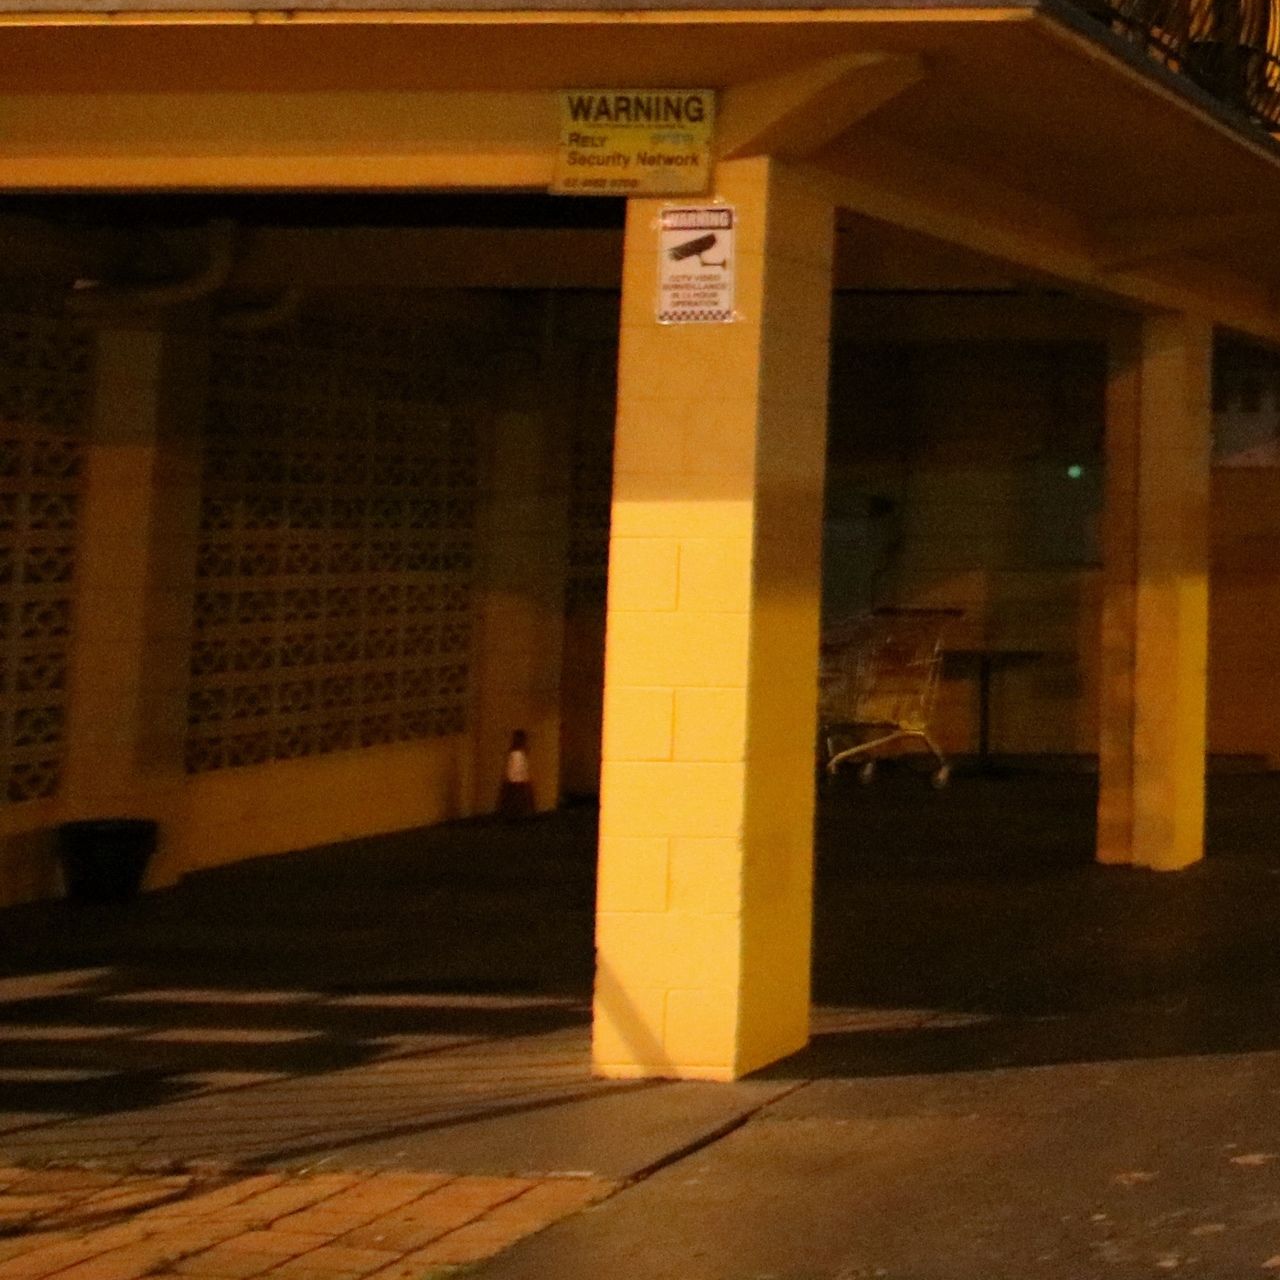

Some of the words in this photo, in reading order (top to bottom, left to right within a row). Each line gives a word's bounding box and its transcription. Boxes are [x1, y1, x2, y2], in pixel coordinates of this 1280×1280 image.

[568, 95, 704, 122] WARNING
[567, 151, 630, 168] Security
[637, 151, 699, 166] Network
